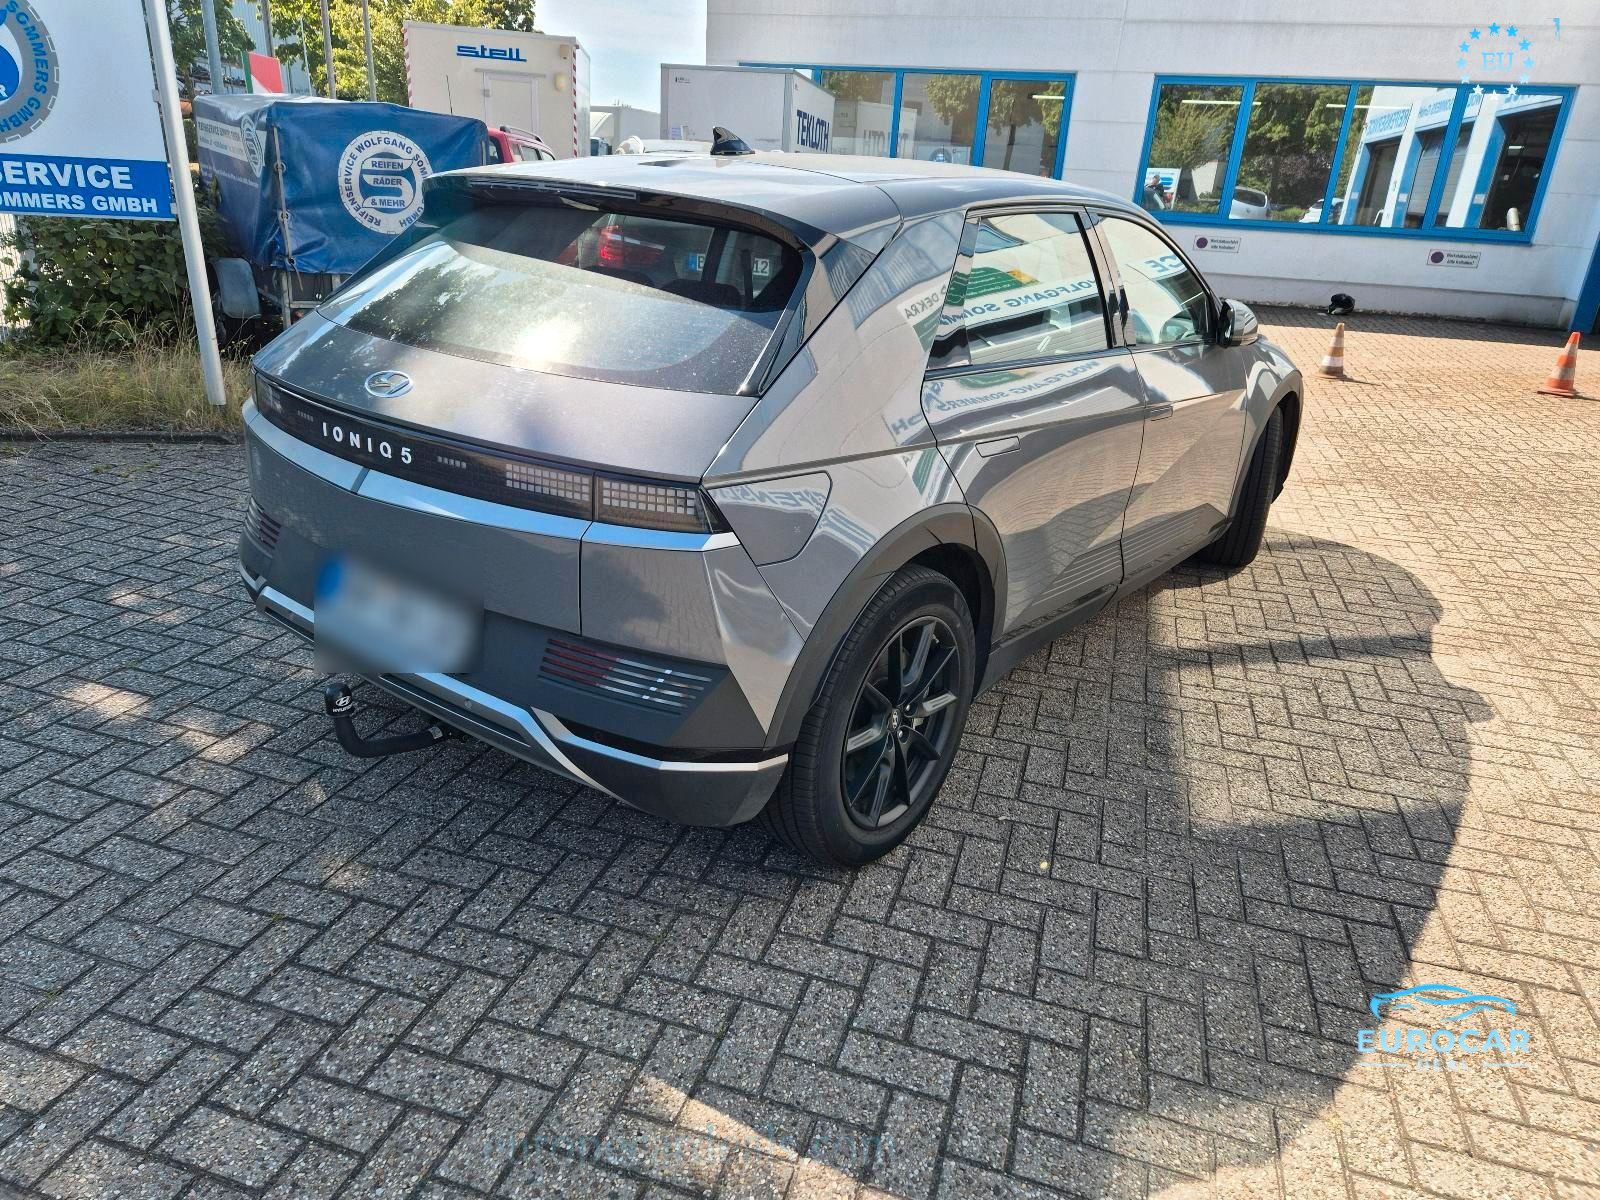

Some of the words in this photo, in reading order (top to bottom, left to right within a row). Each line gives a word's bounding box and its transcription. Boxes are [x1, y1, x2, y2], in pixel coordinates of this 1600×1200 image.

[6, 0, 48, 94] SOMMERS
[456, 45, 527, 62] stell
[796, 109, 830, 152] TEKLOTH
[355, 137, 412, 154] WOLFGANG
[0, 160, 133, 190] ERVICE
[371, 160, 404, 170] REIFEN
[413, 154, 428, 179] SOM
[344, 153, 382, 227] REIFENSERVICE
[373, 177, 402, 186] RÄDER
[0, 191, 86, 211] MMERS
[91, 195, 158, 213] GMBH
[370, 198, 378, 206] &
[379, 199, 405, 207] MEHR
[322, 422, 392, 459] IONIQ
[401, 447, 412, 464] 5
